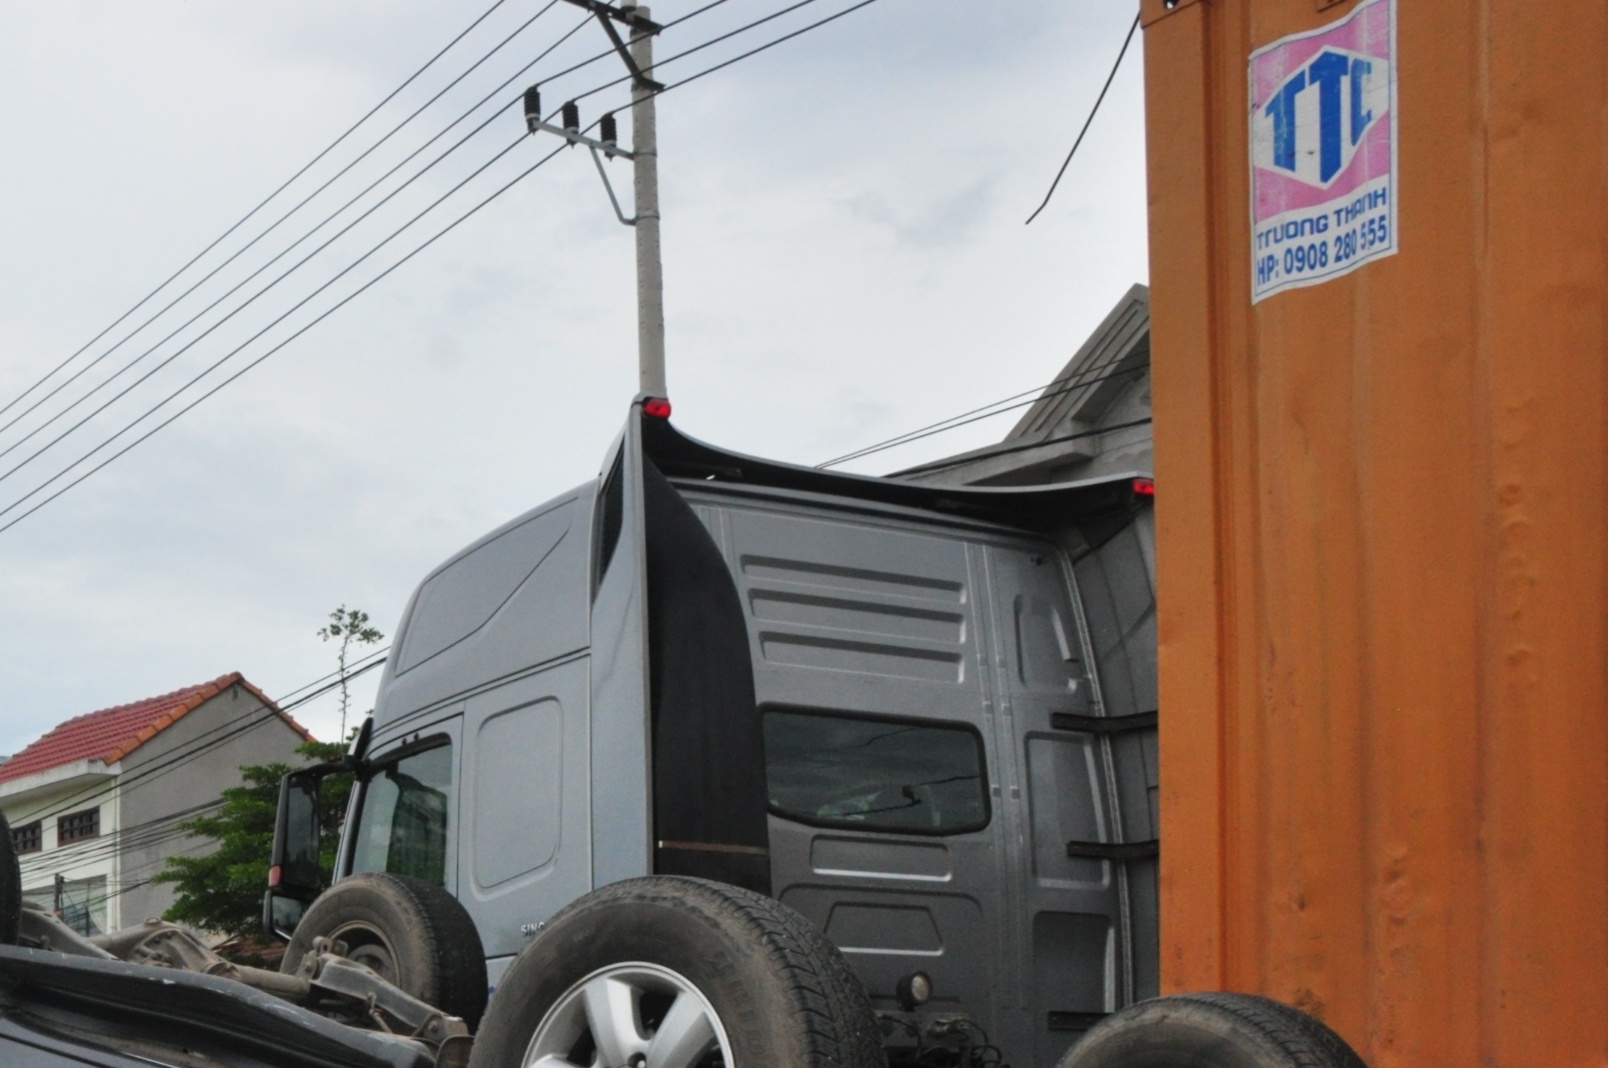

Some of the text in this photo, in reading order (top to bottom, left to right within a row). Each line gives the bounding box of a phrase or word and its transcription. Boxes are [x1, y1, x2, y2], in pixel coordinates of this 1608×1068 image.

[1265, 50, 1372, 183] TTC
[1257, 214, 1387, 286] HP: 0908 280 555
